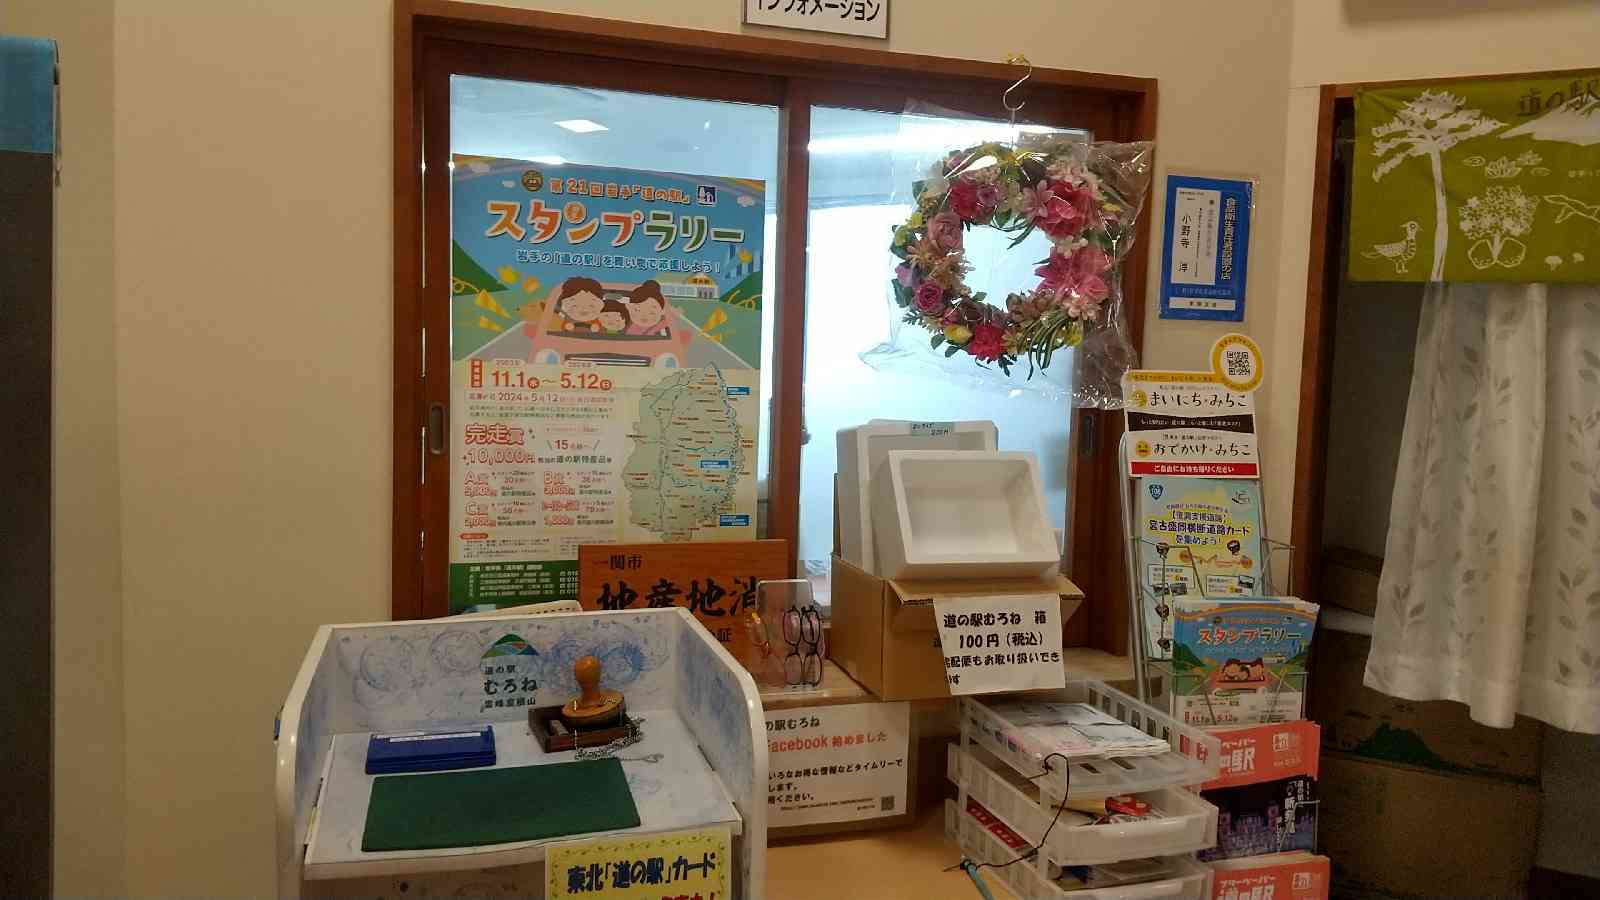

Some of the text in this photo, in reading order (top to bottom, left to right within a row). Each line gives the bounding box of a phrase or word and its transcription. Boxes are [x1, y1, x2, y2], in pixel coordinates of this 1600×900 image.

[485, 199, 745, 252] スタンプラリー
[593, 554, 642, 570] 一関市
[943, 611, 1047, 628] 道の駅むろね 箱
[1200, 627, 1305, 646] スタンプラリー
[484, 664, 516, 675] 道の駅
[484, 677, 538, 695] むろね
[832, 731, 888, 747] 始めました
[567, 852, 716, 893] 東北「道の駅」カード
